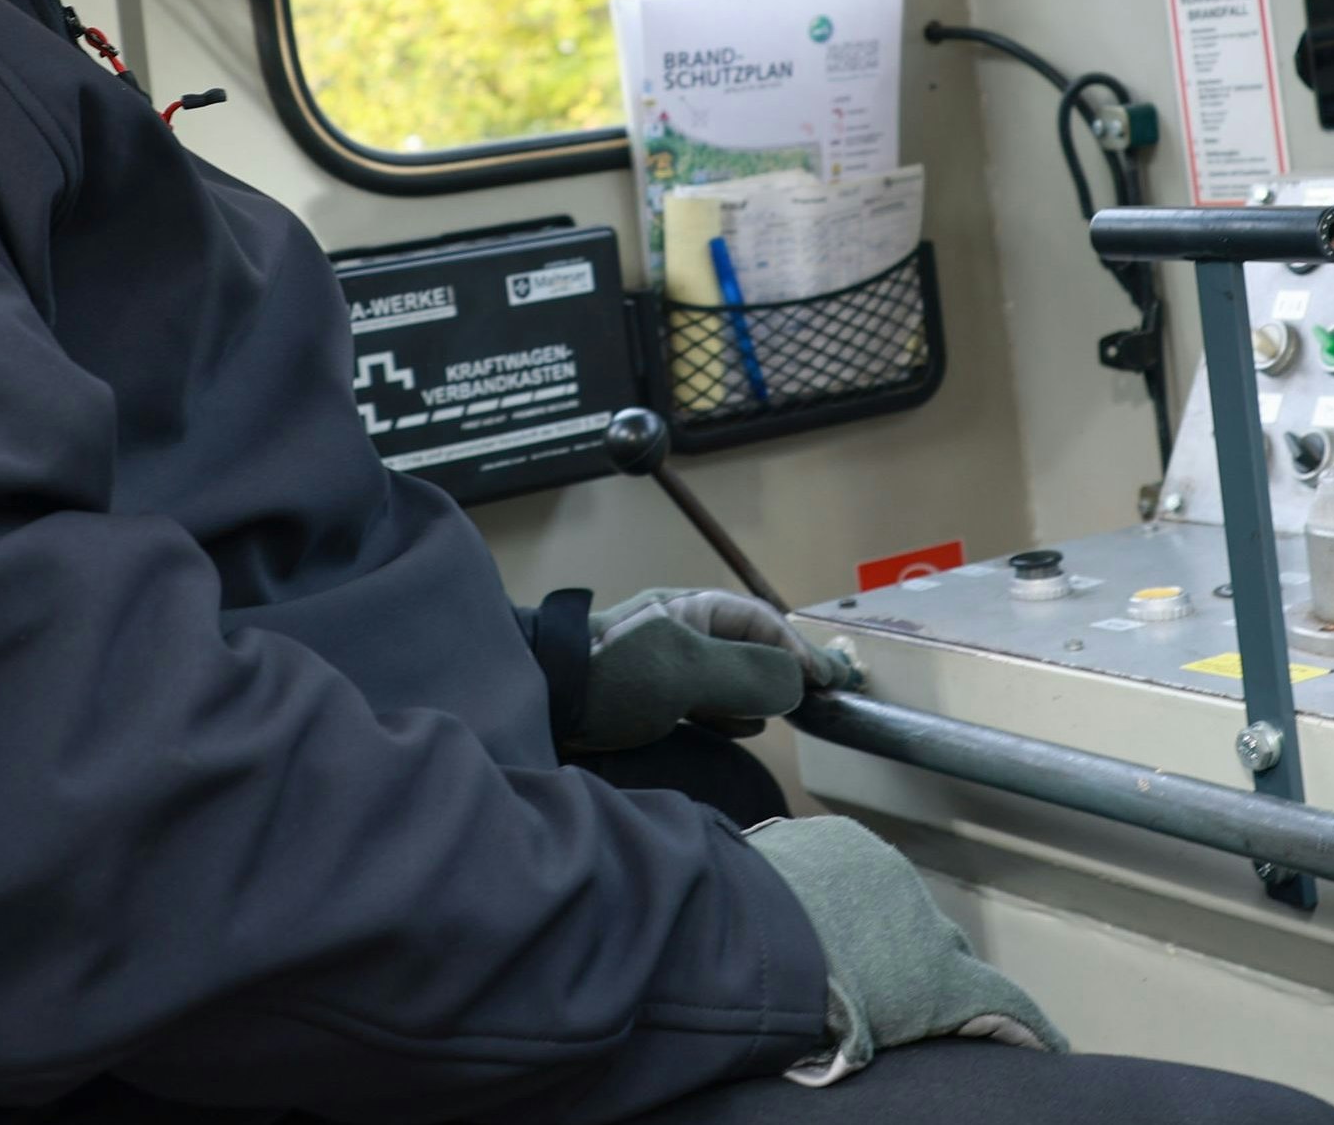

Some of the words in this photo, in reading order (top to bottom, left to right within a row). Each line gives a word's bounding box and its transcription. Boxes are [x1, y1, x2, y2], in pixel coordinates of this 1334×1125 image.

[663, 46, 744, 70] BRAND-
[663, 61, 794, 91] SCHUTZPLAN
[346, 286, 447, 321] A-WERKE
[445, 344, 574, 383] KRAFTWAGEN-
[421, 361, 577, 406] VERBANDKASTEN
